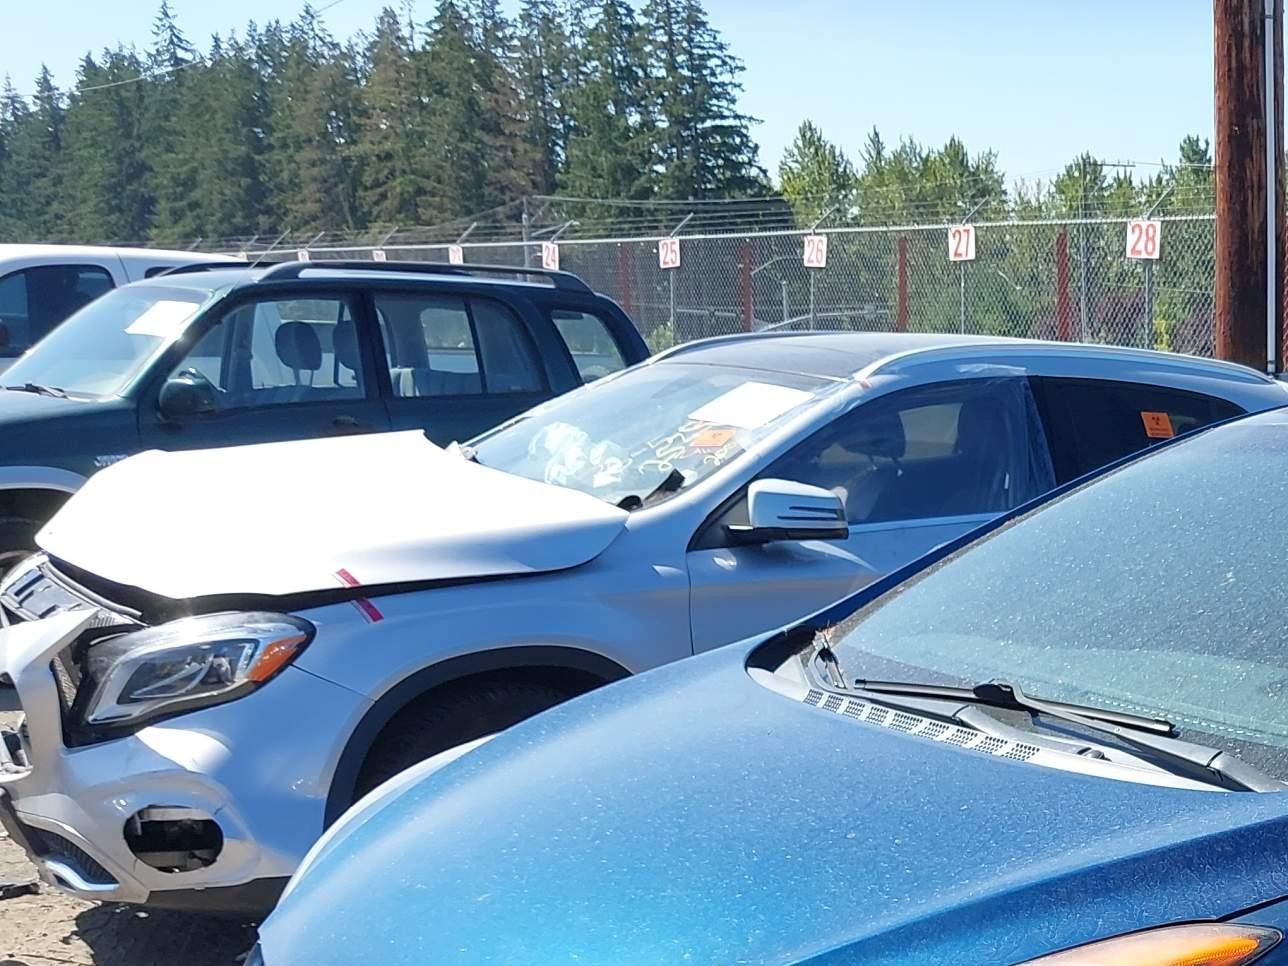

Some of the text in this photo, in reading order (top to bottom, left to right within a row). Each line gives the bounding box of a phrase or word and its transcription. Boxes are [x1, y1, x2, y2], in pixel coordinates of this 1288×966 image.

[661, 241, 677, 265] 25
[805, 238, 824, 265] 26
[952, 228, 971, 258] 27
[1131, 222, 1156, 257] 28
[544, 245, 557, 268] 24
